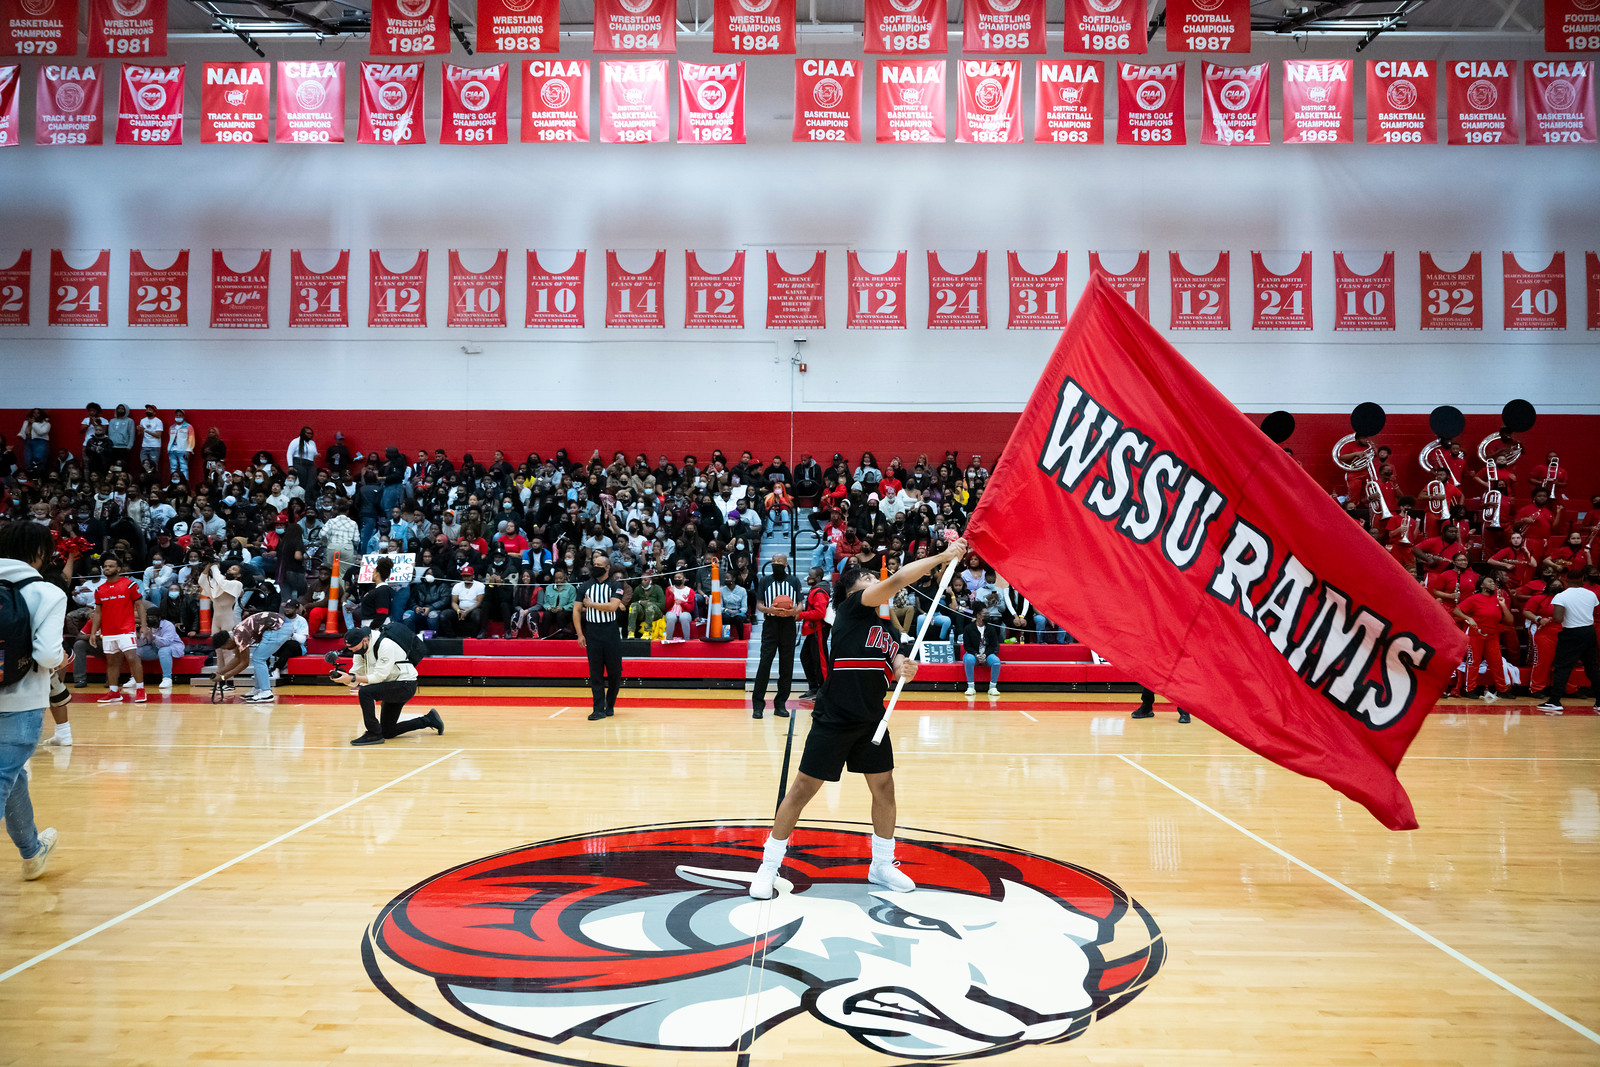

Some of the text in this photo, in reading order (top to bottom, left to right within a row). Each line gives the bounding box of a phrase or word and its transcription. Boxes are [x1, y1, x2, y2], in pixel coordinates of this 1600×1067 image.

[10, 20, 63, 28] BASKETBALL
[493, 16, 542, 24] WRESTLING
[610, 15, 660, 23] WRESTLING
[730, 16, 780, 24] WRESTLING
[883, 15, 927, 24] SOFTBALL
[980, 14, 1030, 22] WRESTLING
[1083, 15, 1127, 23] SOFTBALL
[104, 27, 154, 35] CHAMPIONS
[386, 24, 436, 35] CHAMPIONS
[493, 26, 543, 34] CHAMPIONS
[609, 23, 661, 31] CHAMPIONS
[729, 24, 781, 32] CHAMPIONS
[880, 23, 932, 32] CHAMPIONS
[979, 22, 1031, 31] CHAMPIONS
[1078, 22, 1131, 31] CHAMPIONS
[1183, 25, 1234, 33] CHAMPIONS
[11, 30, 61, 38] CHAMPIONS
[982, 33, 1029, 48] 1985
[15, 41, 57, 54] 1979
[106, 38, 149, 53] 1981
[389, 35, 435, 52] 1982
[495, 37, 540, 50] 1983
[612, 34, 659, 49] 1984
[732, 35, 779, 50] 1984
[882, 34, 930, 50] 1985
[1081, 34, 1129, 50] 1986
[1186, 37, 1231, 50] 1987
[46, 66, 96, 81] CIAA
[285, 63, 337, 78] CIAA
[530, 61, 581, 77] CIAA
[605, 66, 663, 82] NAIA
[683, 64, 737, 80] CIAA
[802, 60, 854, 76] CIAA
[882, 67, 940, 83] NAIA
[1042, 65, 1099, 82] NAIA
[1288, 65, 1346, 82] NAIA
[1375, 62, 1428, 78] CIAA
[1455, 62, 1508, 78] CIAA
[1533, 62, 1586, 78] CIAA
[207, 69, 264, 84] NAIA
[50, 133, 86, 144] 1959
[131, 129, 170, 141] 1959
[216, 131, 253, 142] 1960
[292, 131, 329, 142] 1960
[455, 128, 493, 141] 1961
[538, 130, 572, 140] 1961
[617, 131, 652, 141] 1961
[692, 128, 733, 141] 1962
[808, 130, 845, 140] 1962
[893, 130, 929, 141] 1962
[1051, 131, 1088, 142] 1963
[1132, 129, 1172, 141] 1963
[1300, 130, 1337, 141] 1965
[1384, 131, 1422, 143] 1966
[1465, 132, 1502, 143] 1967
[1543, 131, 1581, 142] 1970
[56, 286, 101, 311] 24
[137, 286, 181, 311] 23
[220, 291, 260, 305] 50th
[299, 288, 341, 312] 34
[377, 288, 420, 312] 42
[456, 288, 500, 312] 40
[535, 288, 576, 313] 10
[618, 288, 658, 313] 14
[695, 289, 735, 313] 12
[857, 290, 897, 314] 12
[936, 290, 980, 314] 24
[1018, 290, 1059, 314] 31
[1179, 290, 1220, 315] 12
[1261, 290, 1304, 315] 24
[1344, 291, 1385, 315] 10
[1428, 289, 1474, 314] 32
[1512, 289, 1557, 314] 40
[1038, 376, 1435, 731] WSSU RAMS
